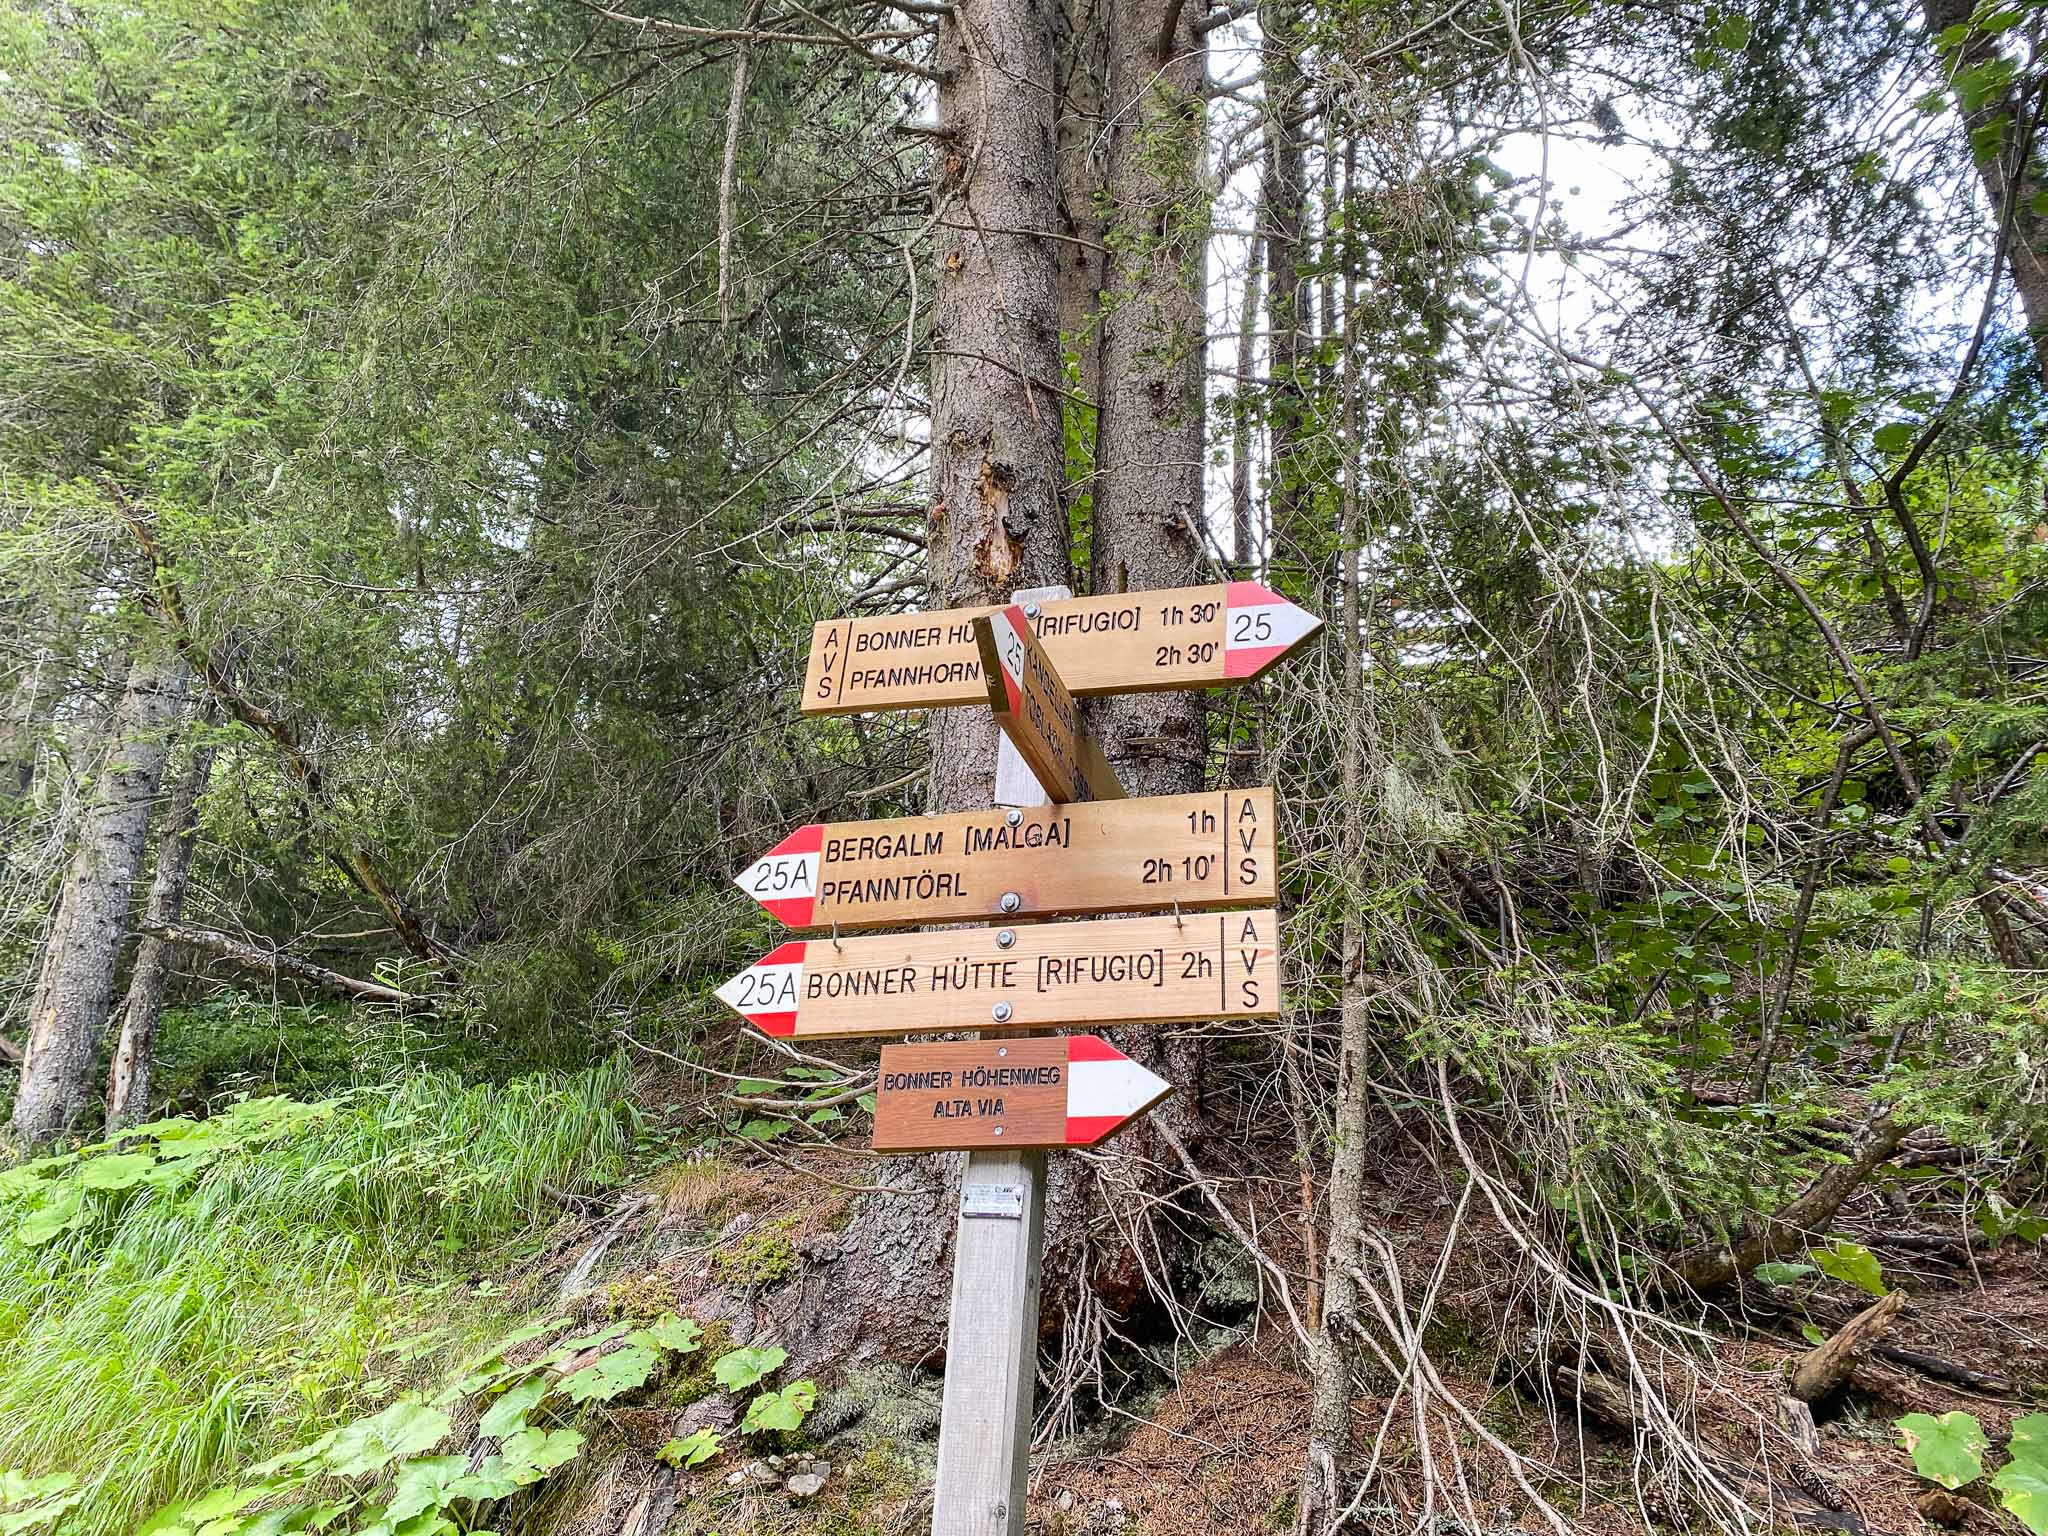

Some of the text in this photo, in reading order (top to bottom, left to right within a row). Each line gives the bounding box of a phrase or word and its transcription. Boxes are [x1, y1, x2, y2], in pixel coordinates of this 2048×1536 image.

[856, 627, 941, 652] BONNER
[1036, 606, 1141, 639] [RIFUGIO]
[1160, 606, 1184, 626] 1h
[1190, 602, 1221, 624] 30'
[1234, 613, 1272, 642] 25
[850, 642, 1219, 690] PFANNHORN 2h 30'
[1006, 632, 1022, 677] 25
[825, 809, 1216, 863] BERGALM [MALGA] 1h
[754, 859, 810, 892] 25A
[820, 854, 1216, 905] PFANNTÖRL 2h 10'
[736, 972, 797, 1007] 25A
[807, 948, 1212, 999] BONNER HÜTTE [RIFUGIO] 2h
[883, 1065, 1061, 1091] BONNER HÖHENWEG
[932, 1098, 1006, 1118] ALTA VIA
